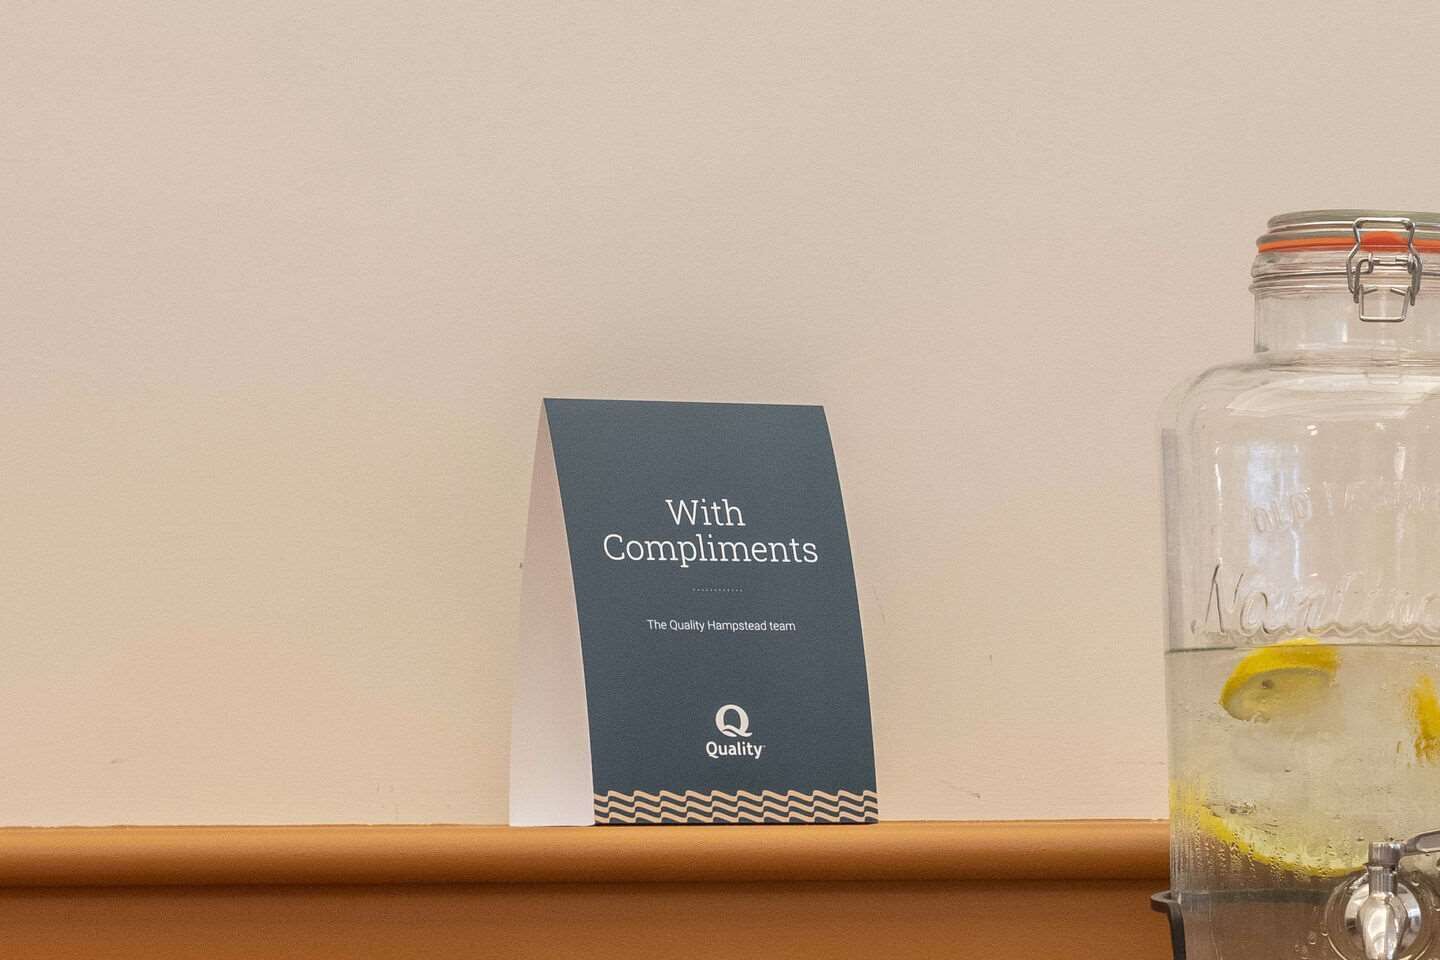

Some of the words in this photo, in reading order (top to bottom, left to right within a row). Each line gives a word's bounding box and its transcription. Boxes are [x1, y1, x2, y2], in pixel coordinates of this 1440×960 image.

[665, 498, 746, 527] With
[603, 532, 819, 568] Compliments
[647, 619, 667, 630] The
[669, 619, 705, 633] Quality
[708, 619, 767, 633] Hampstead
[769, 620, 796, 633] team
[706, 741, 762, 759] Quality
